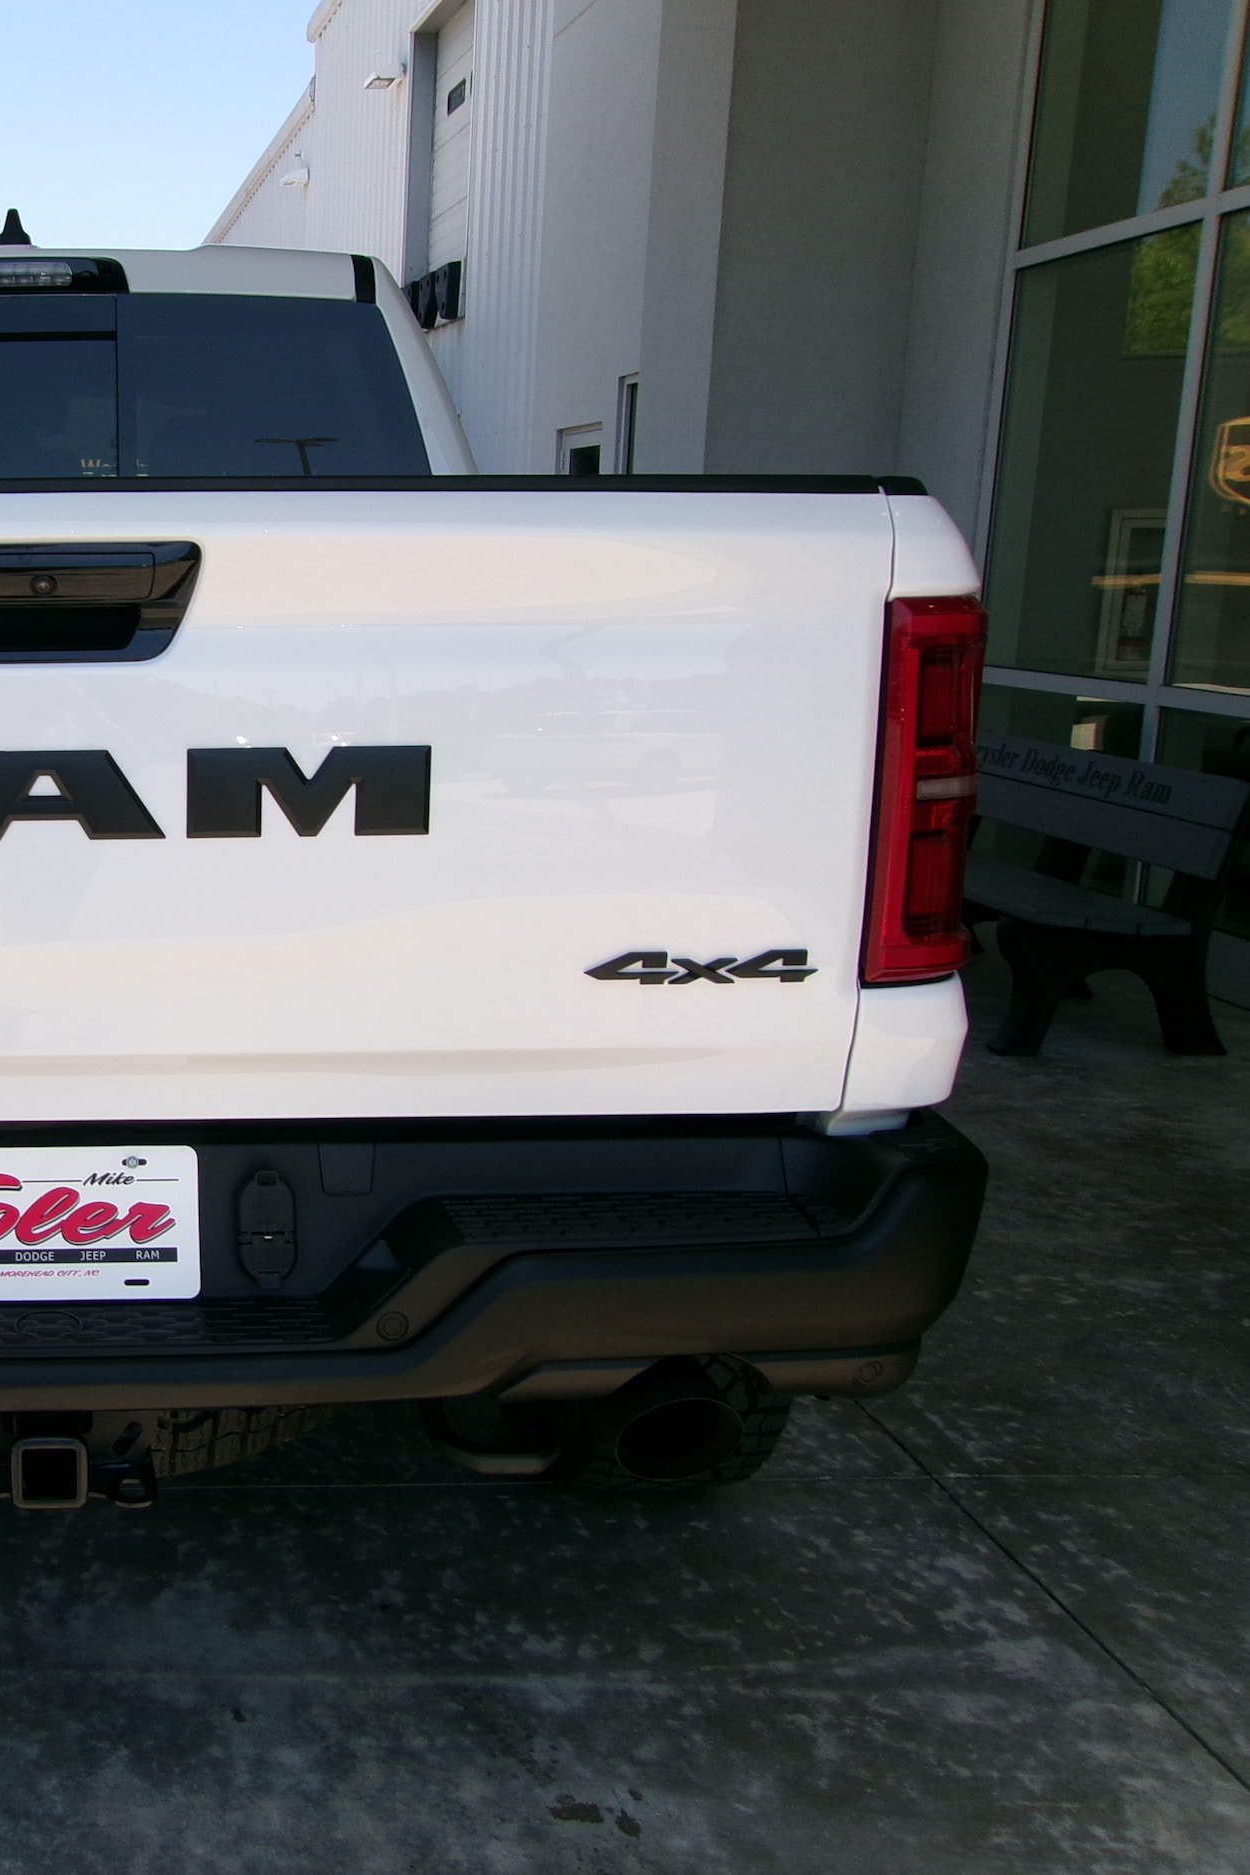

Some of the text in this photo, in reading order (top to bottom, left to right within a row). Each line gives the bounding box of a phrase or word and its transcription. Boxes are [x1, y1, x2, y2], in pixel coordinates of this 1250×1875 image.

[1020, 747, 1075, 785] Dodge
[1077, 760, 1122, 798] Jeep
[1126, 769, 1173, 804] Ram
[583, 949, 819, 985] 4x4
[83, 1172, 136, 1187] Mike
[15, 1251, 55, 1262] DODGE
[80, 1251, 107, 1261] JEEP
[136, 1250, 160, 1260] RAM
[84, 1269, 100, 1277] NC
